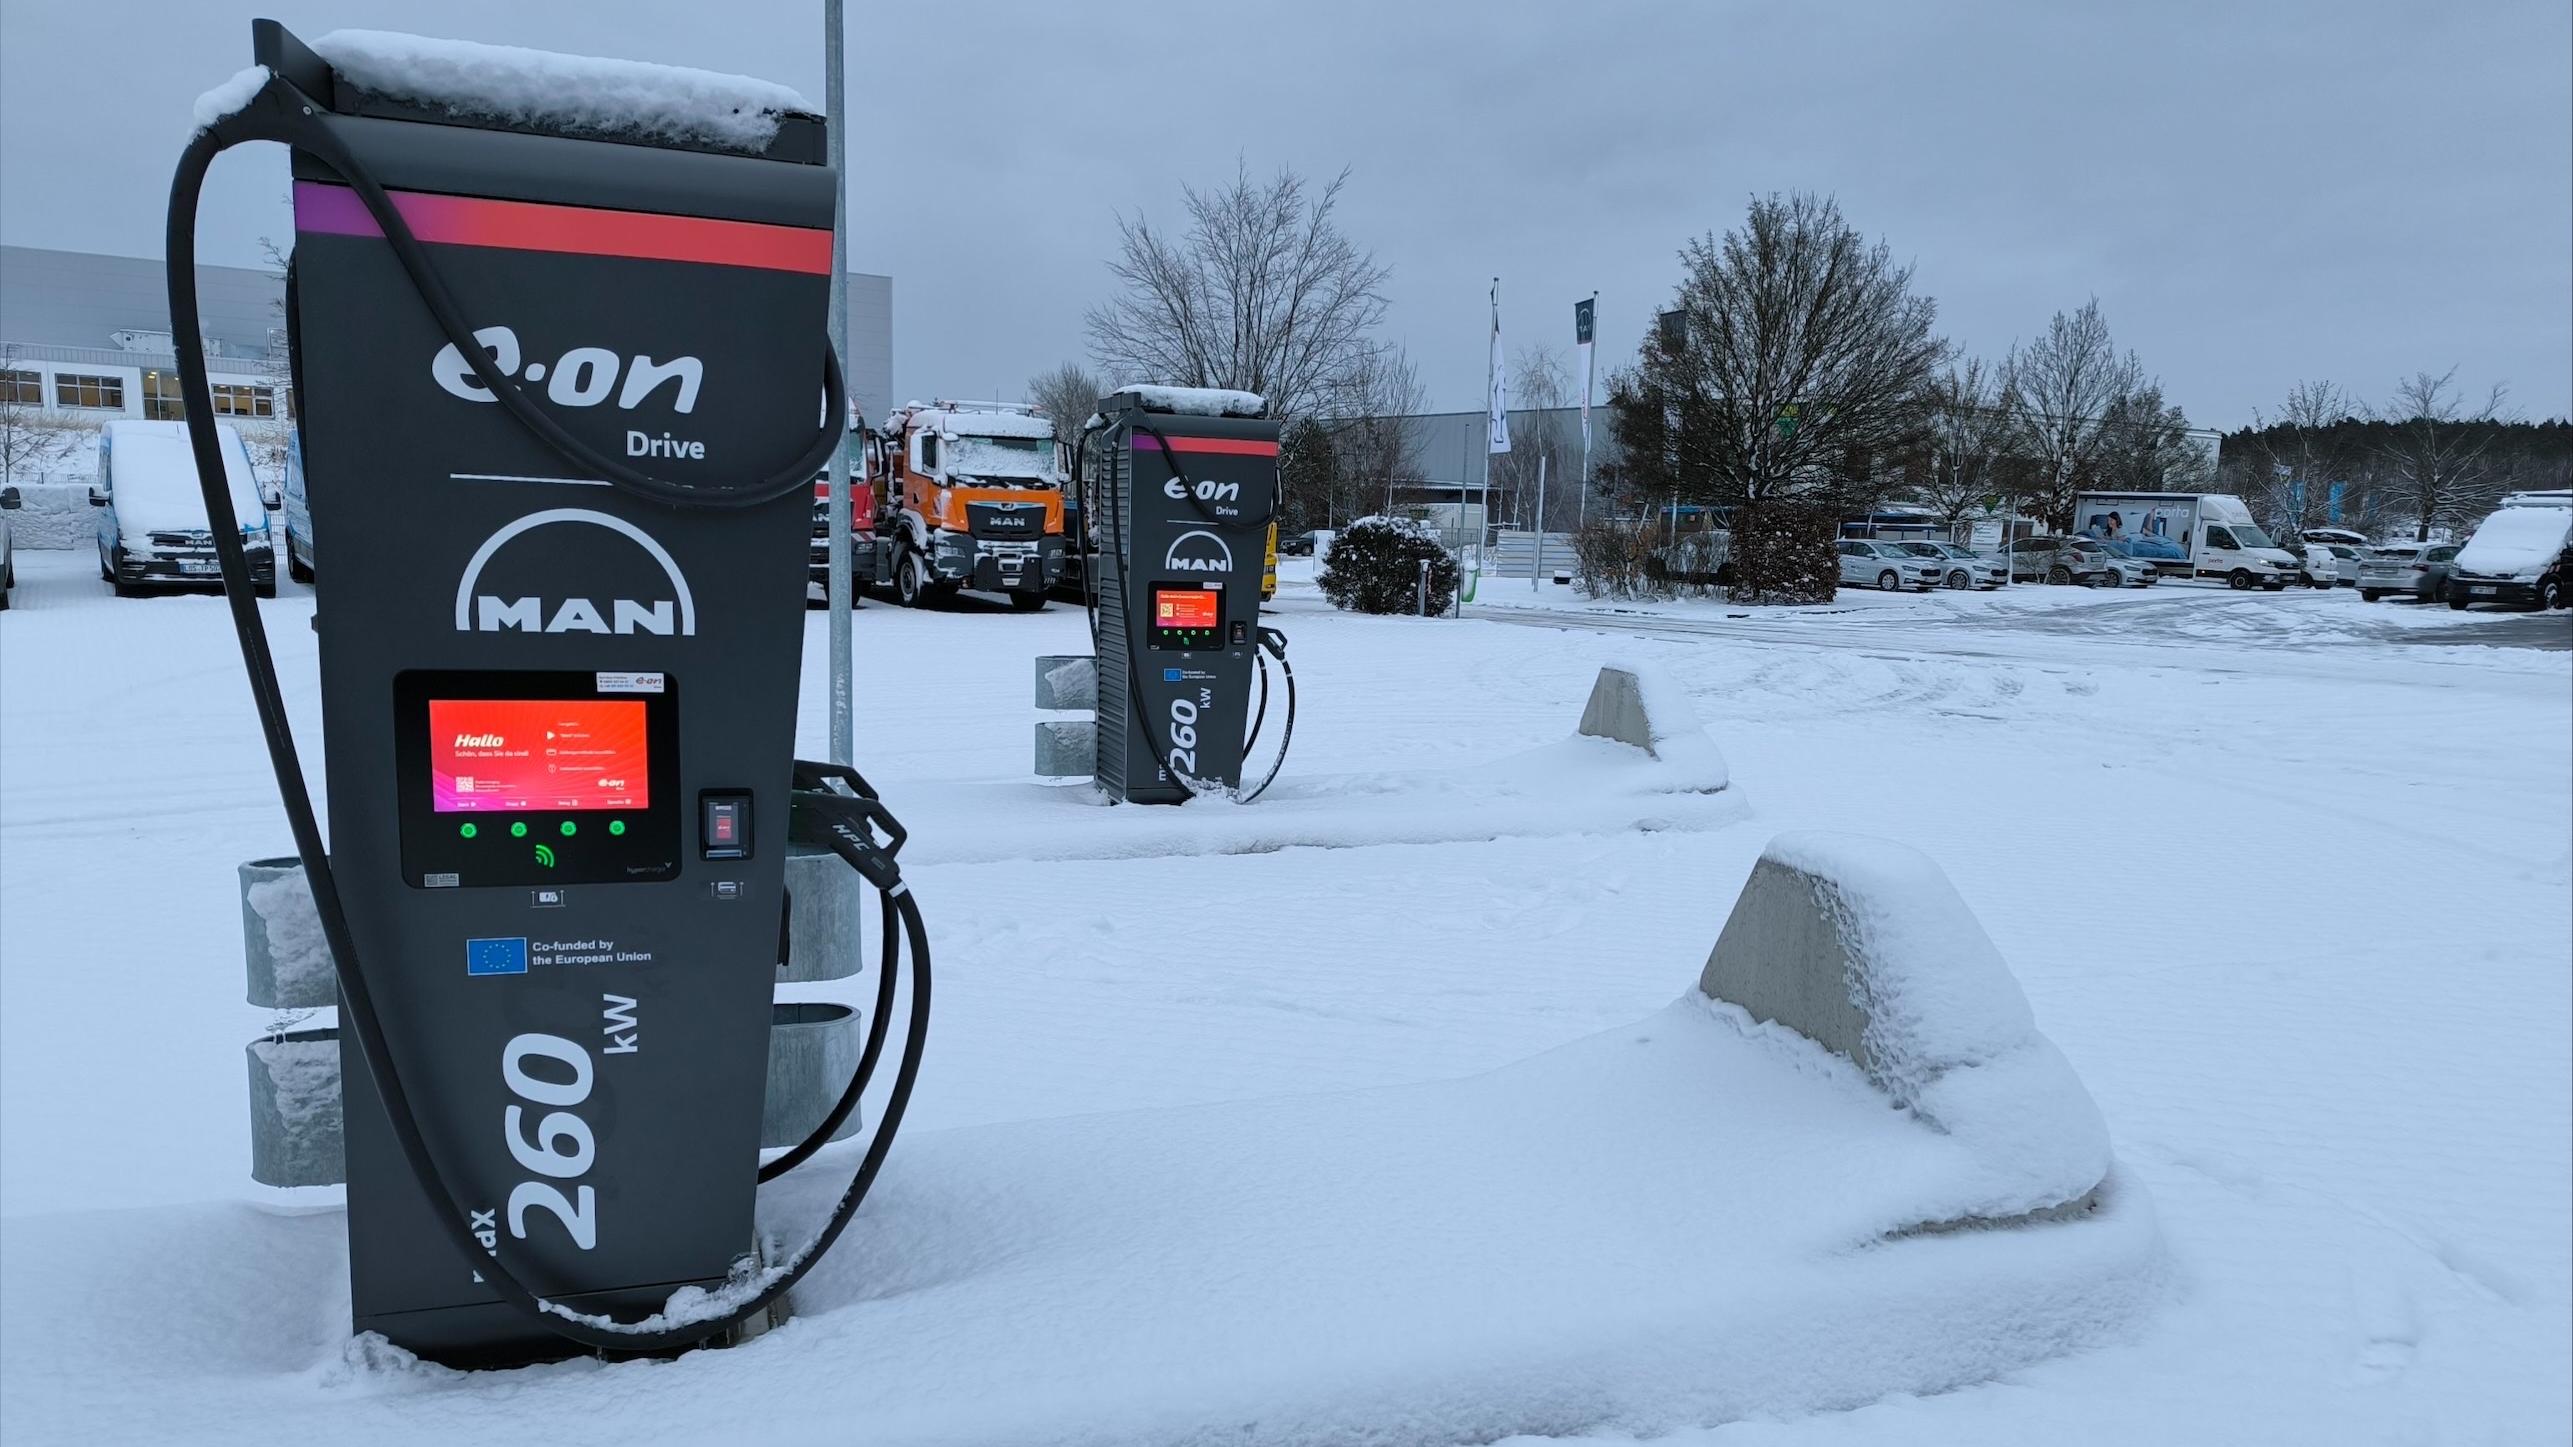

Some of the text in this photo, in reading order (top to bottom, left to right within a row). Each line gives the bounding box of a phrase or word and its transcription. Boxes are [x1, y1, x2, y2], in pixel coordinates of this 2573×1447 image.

[627, 431, 705, 459] Drive
[990, 518, 1025, 526] MAN
[1216, 506, 1239, 516] Drive
[2154, 505, 2190, 518] porta
[1171, 558, 1227, 572] MAN
[478, 595, 674, 635] MAN
[1200, 687, 1212, 709] kW
[454, 734, 504, 748] Hallo
[1170, 698, 1198, 774] 260
[832, 824, 870, 852] HPC
[532, 940, 614, 952] Co-funded by
[532, 951, 651, 965] the European Union
[603, 993, 638, 1054] kW
[503, 1033, 596, 1250] 260
[471, 1208, 497, 1283] ax
